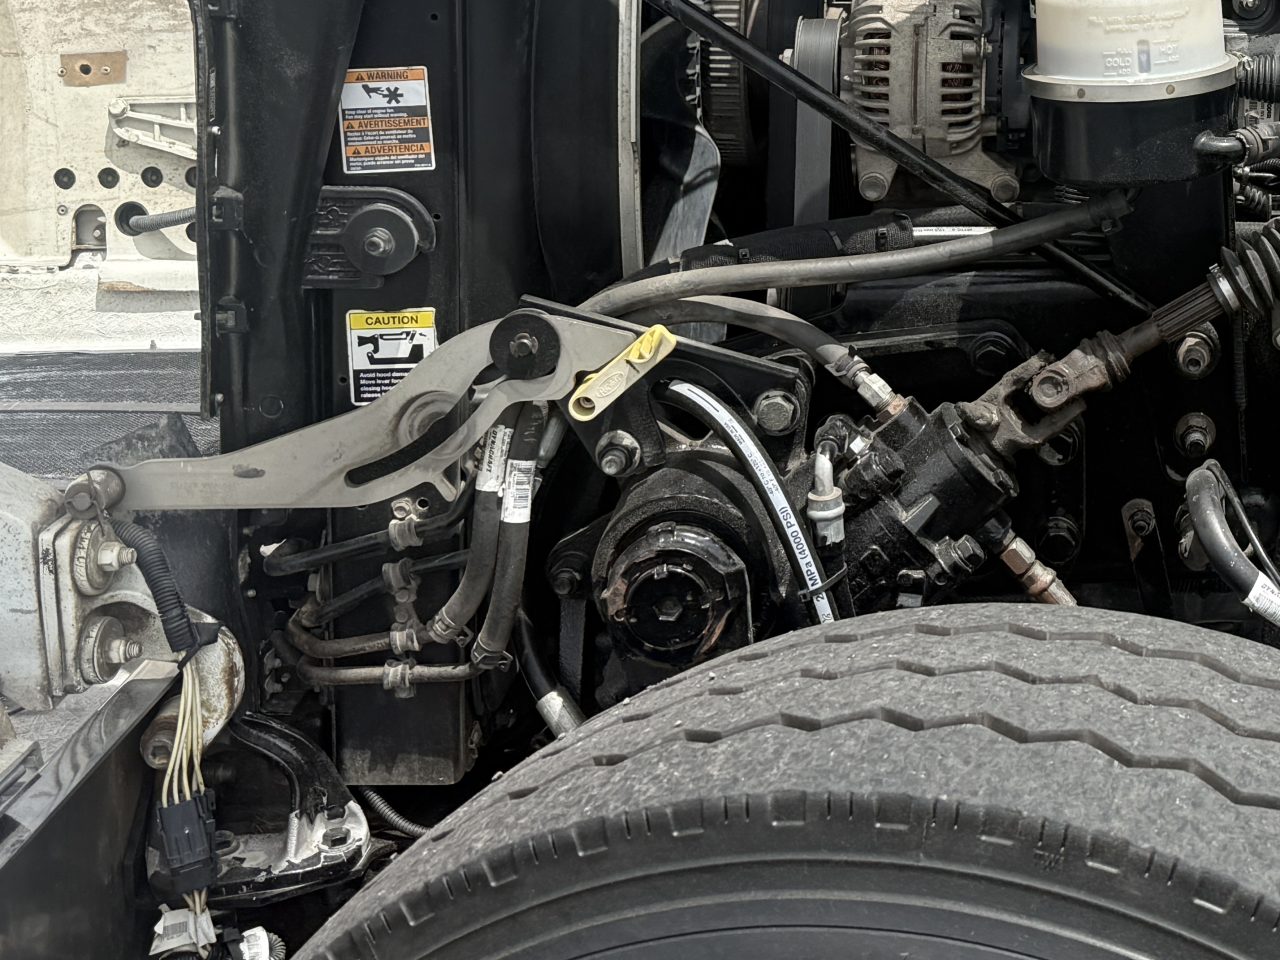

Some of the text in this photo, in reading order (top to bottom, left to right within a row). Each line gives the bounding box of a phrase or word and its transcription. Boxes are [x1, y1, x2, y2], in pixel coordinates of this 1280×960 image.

[1105, 58, 1132, 67] COLD
[366, 70, 409, 81] WARNING
[357, 118, 427, 129] AVERTISSEMENT
[364, 143, 426, 155] ADVERTENCIA
[365, 315, 419, 326] CAUTION
[778, 504, 796, 529] PSI)
[789, 529, 809, 561] (4000
[802, 560, 820, 587] MPa
